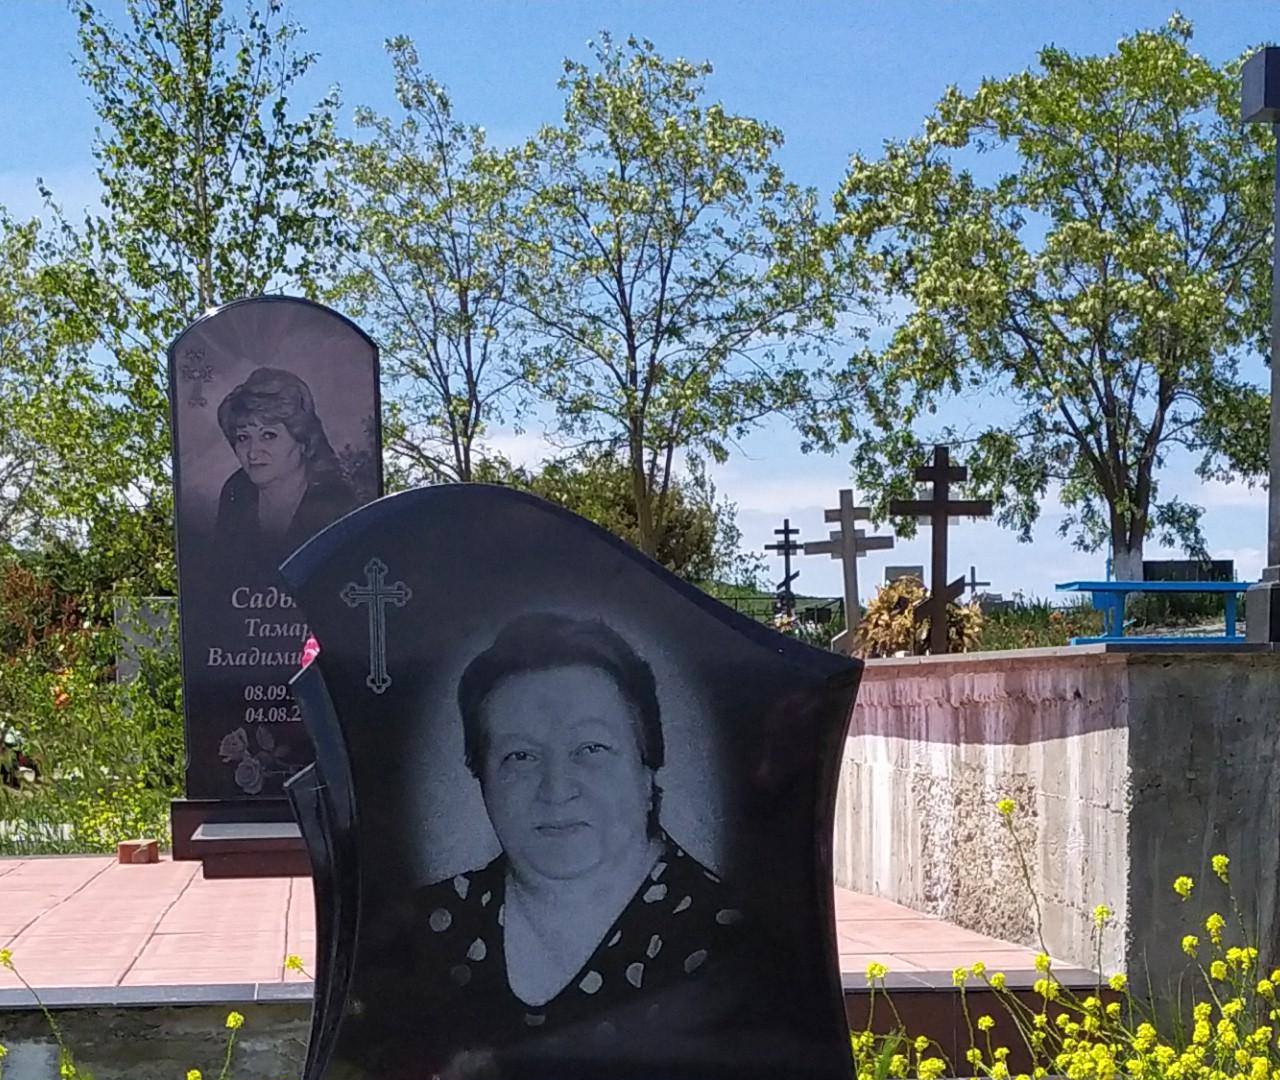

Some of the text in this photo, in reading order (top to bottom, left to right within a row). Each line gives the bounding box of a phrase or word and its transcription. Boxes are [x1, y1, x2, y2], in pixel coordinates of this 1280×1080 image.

[245, 618, 312, 643] Тамар
[207, 647, 303, 667] Владими
[244, 684, 297, 701] 08.09.
[245, 704, 302, 723] 04.08.2
